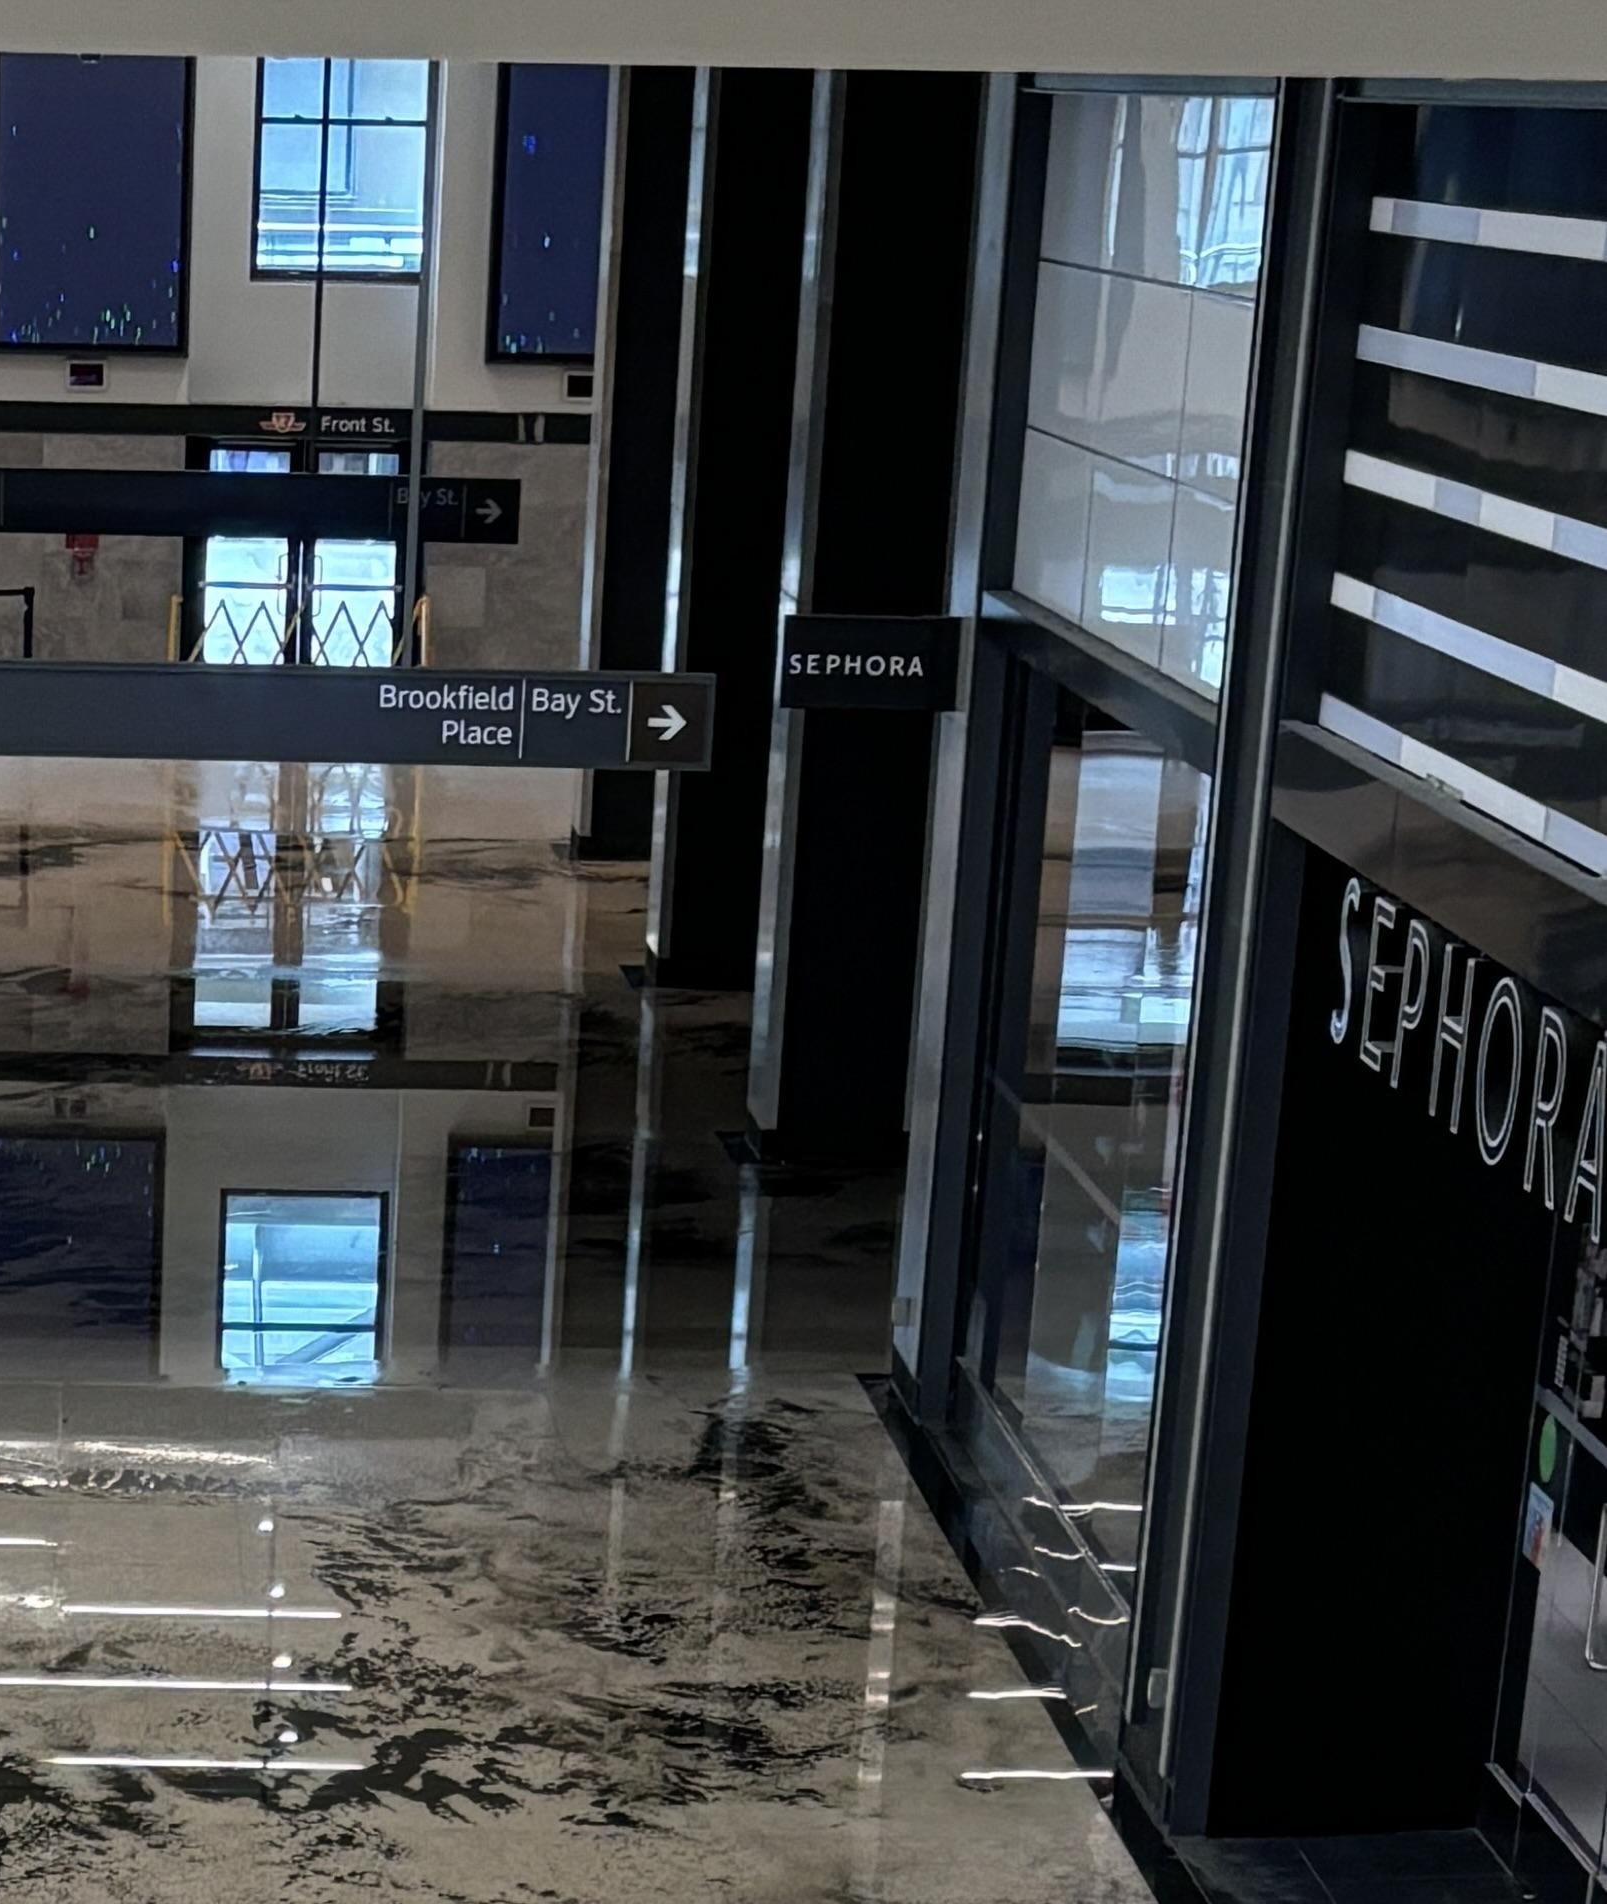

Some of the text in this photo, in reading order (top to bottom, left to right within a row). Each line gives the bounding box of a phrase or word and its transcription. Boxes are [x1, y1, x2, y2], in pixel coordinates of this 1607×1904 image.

[320, 415, 395, 433] Front St.
[397, 487, 431, 508] By
[788, 653, 924, 677] SEPHORA
[379, 684, 514, 711] Brookfield
[531, 688, 623, 719] Bay St.
[442, 720, 512, 745] Place
[1329, 876, 1607, 1245] SEPHORA
